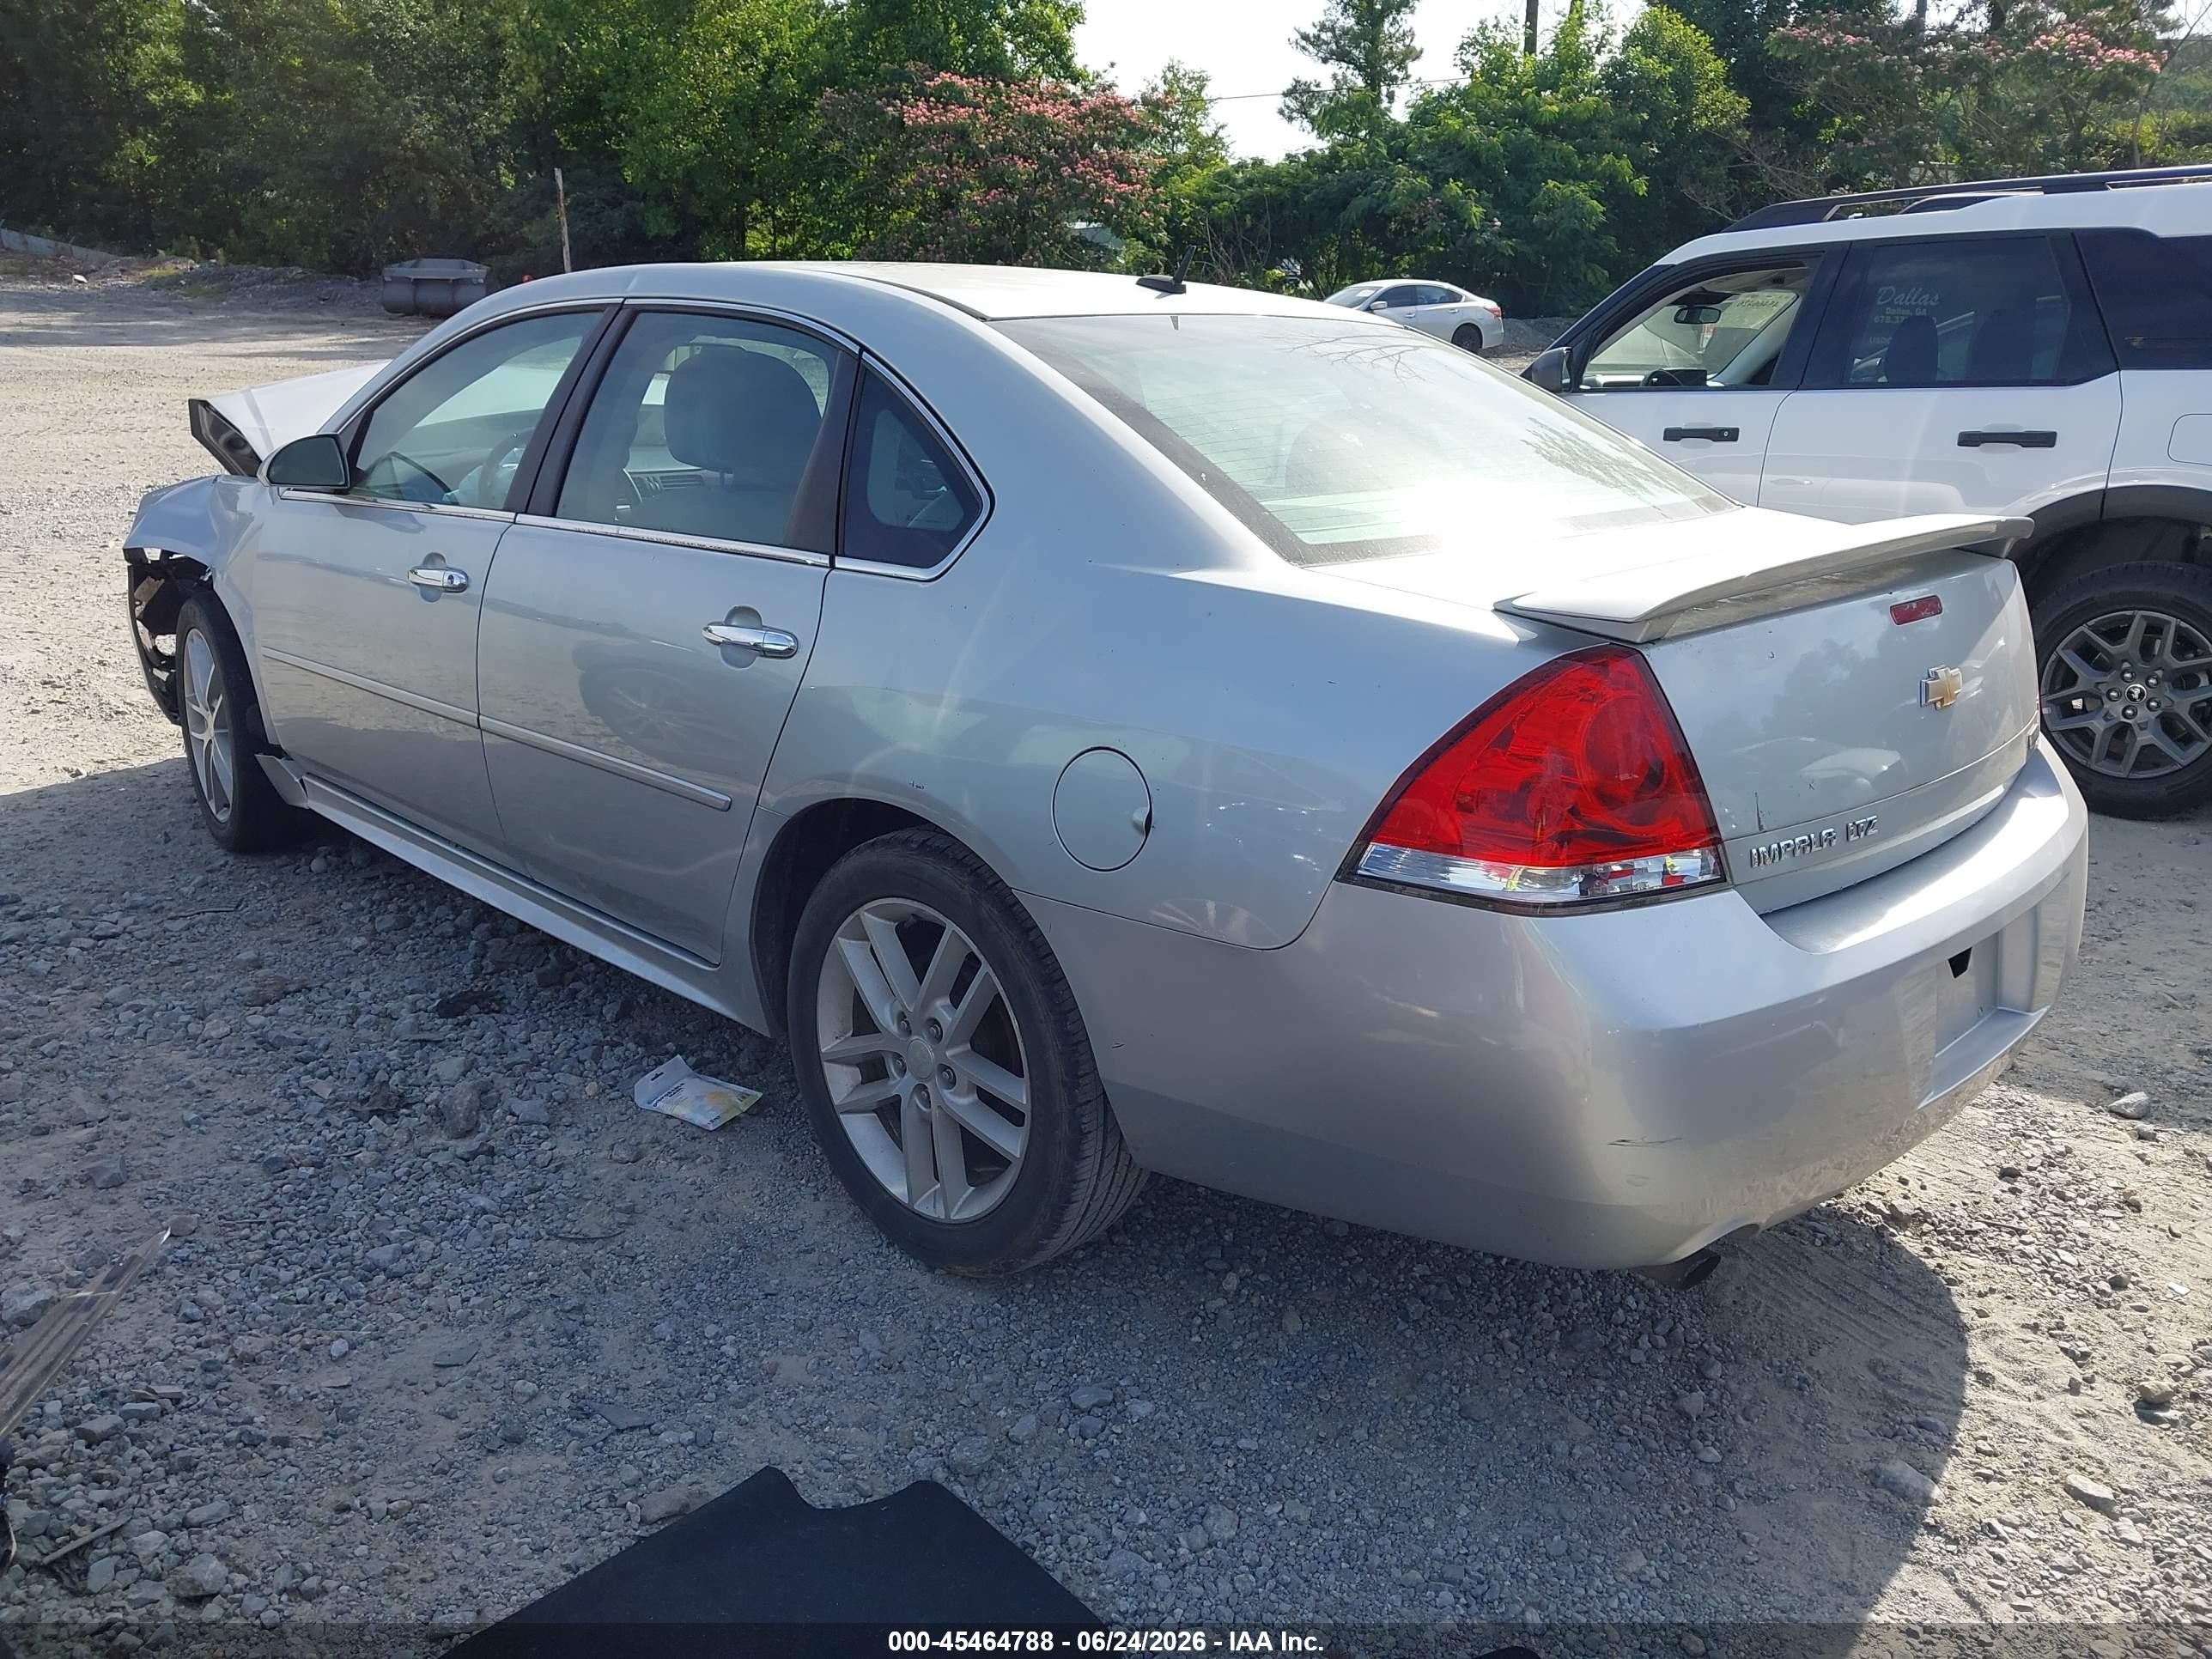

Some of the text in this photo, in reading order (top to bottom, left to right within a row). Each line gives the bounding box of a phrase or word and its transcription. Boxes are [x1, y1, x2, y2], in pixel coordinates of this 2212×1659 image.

[1876, 286, 1940, 306] Dallas
[1750, 815, 1879, 868] IMPALA LTZ
